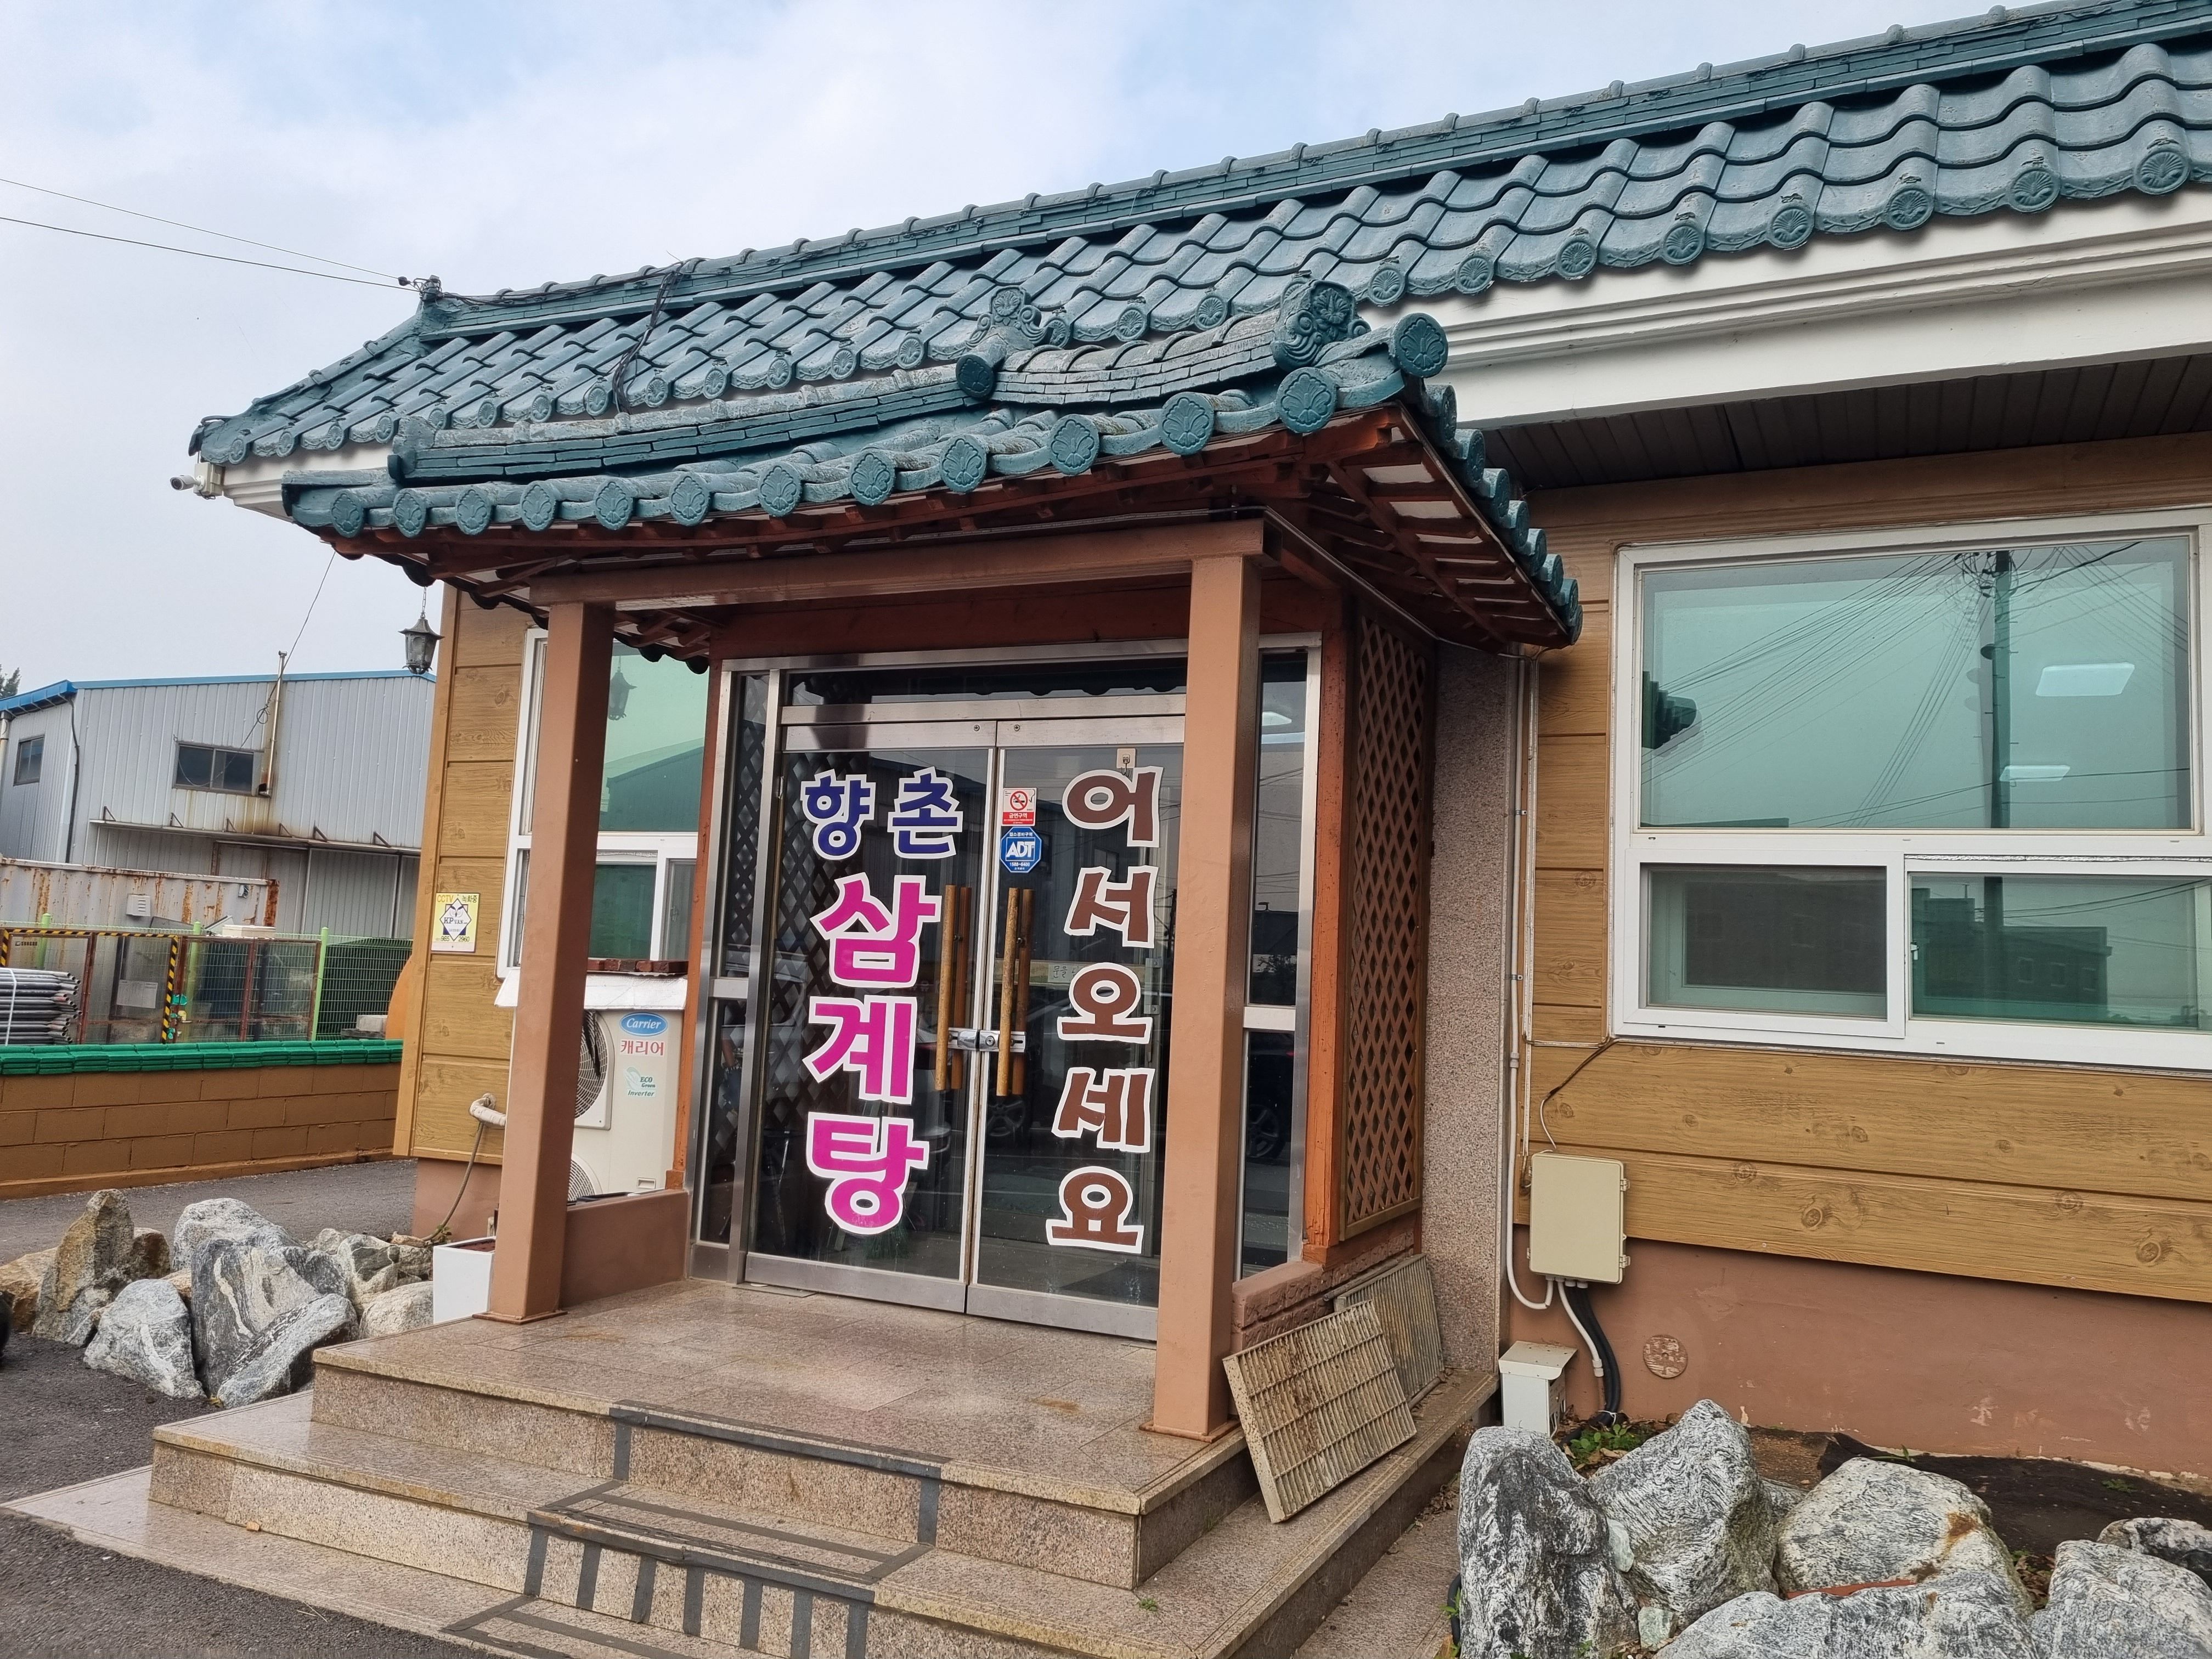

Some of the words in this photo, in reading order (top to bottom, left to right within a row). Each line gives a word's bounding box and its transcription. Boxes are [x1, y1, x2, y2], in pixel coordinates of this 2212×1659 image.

[800, 766, 963, 860] 향촌
[1006, 841, 1035, 857] ADT
[1053, 965, 1068, 979] 문을
[1046, 766, 1163, 1254] 어서오세요
[626, 1018, 662, 1030] Carrier
[620, 1040, 664, 1056] 캐리어
[803, 874, 941, 1235] 삼계탕
